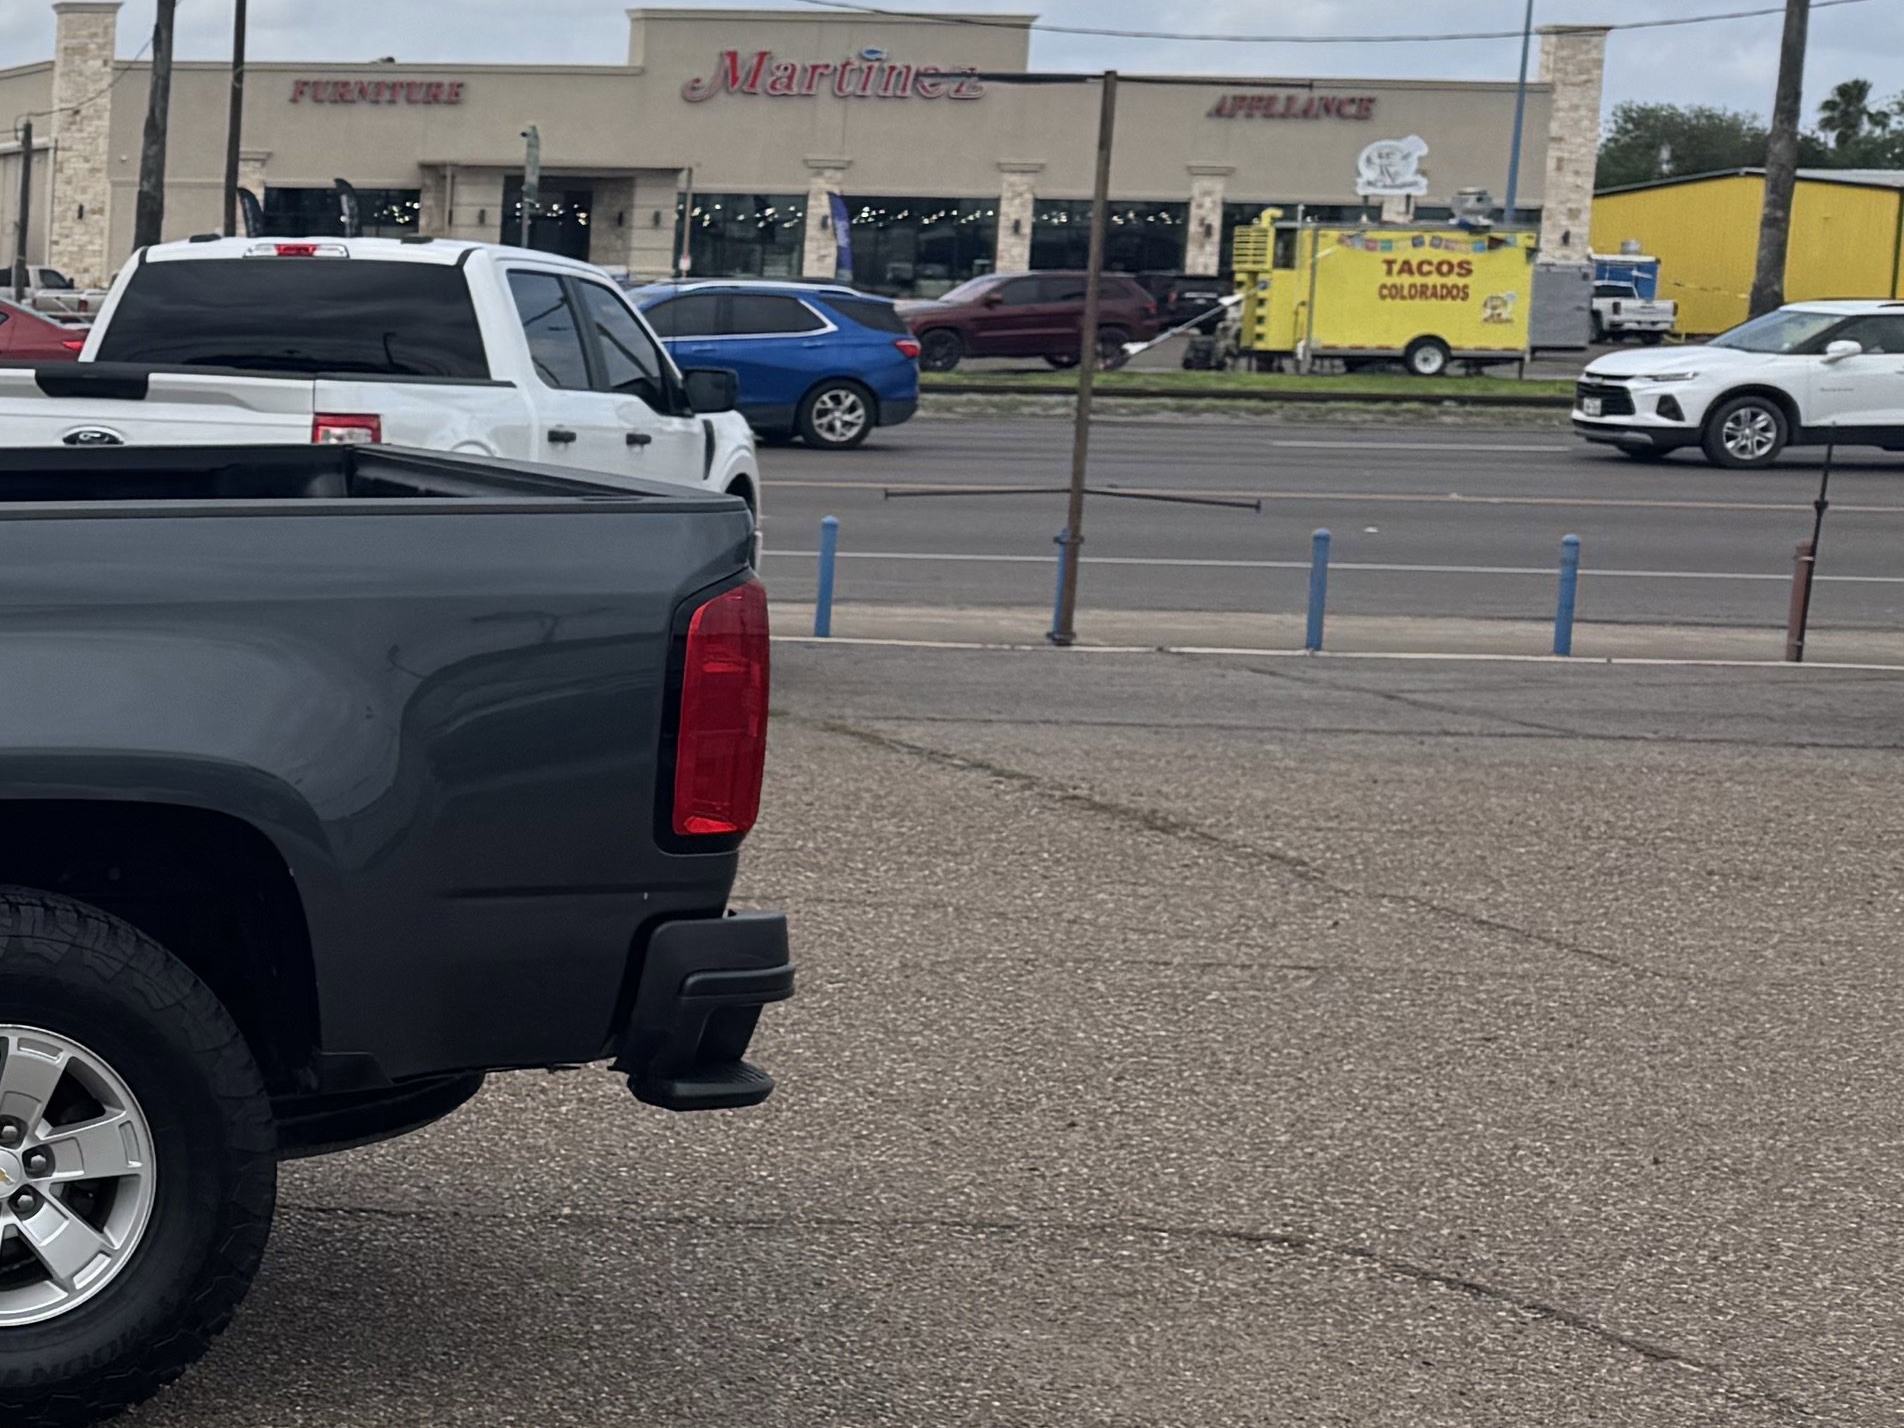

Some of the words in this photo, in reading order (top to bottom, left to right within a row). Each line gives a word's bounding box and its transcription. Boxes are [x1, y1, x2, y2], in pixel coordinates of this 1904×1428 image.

[682, 45, 987, 102] Martinez
[289, 79, 464, 105] FURNITURE
[1206, 94, 1376, 120] APPLIANCE
[1382, 259, 1474, 277] TACOS
[1378, 283, 1470, 302] COLORADOS
